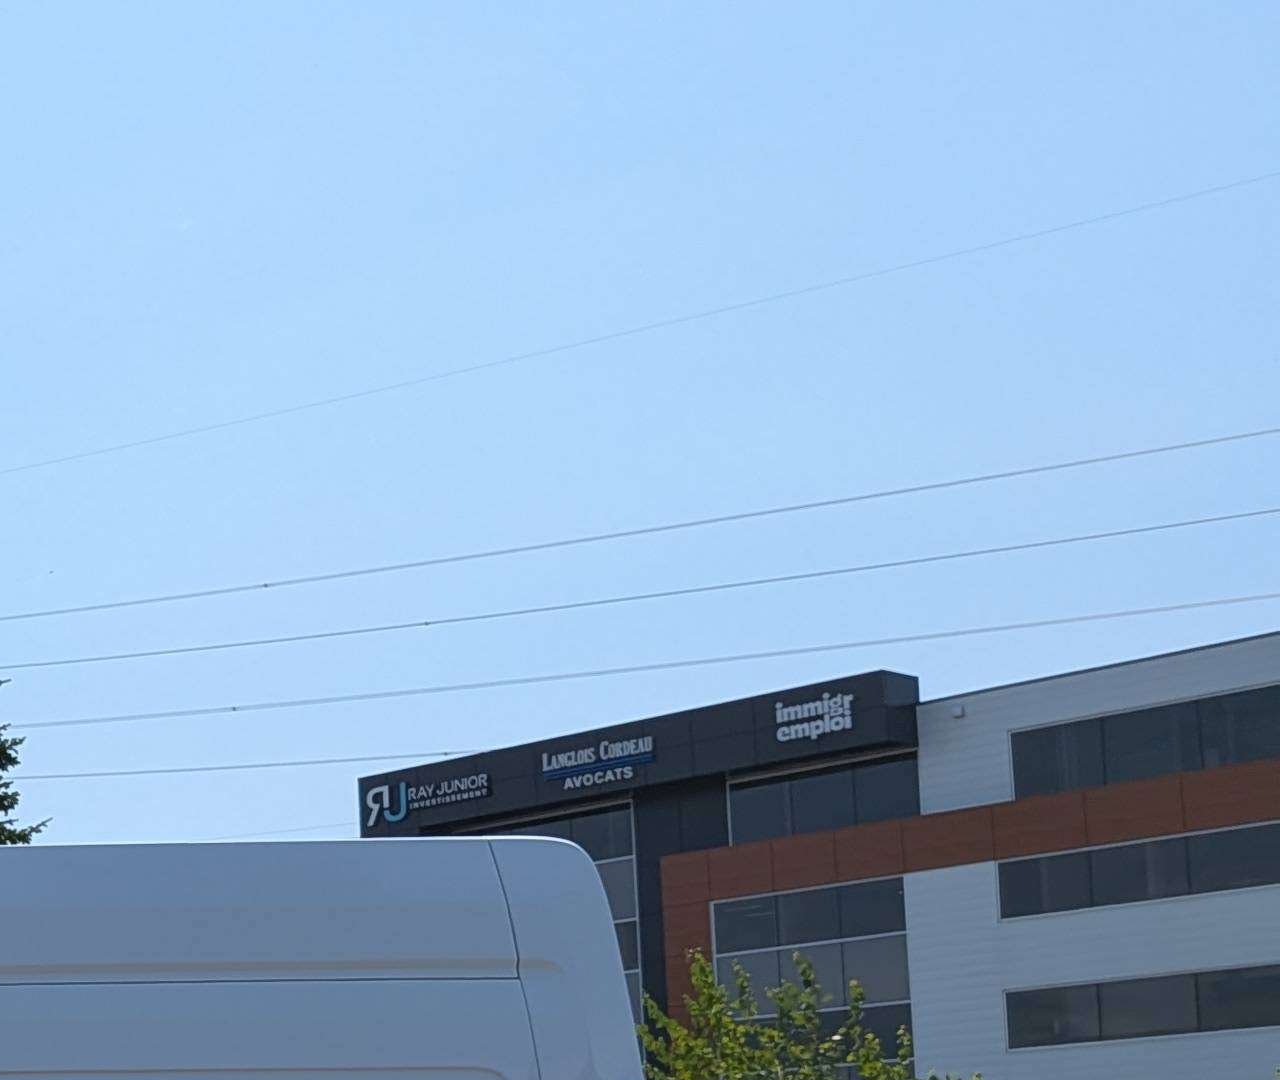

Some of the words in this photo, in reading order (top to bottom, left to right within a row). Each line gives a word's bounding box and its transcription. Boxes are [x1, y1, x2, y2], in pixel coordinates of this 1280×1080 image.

[775, 692, 854, 724] immigr
[776, 708, 853, 742] emploi
[407, 783, 434, 801] RAY
[436, 773, 489, 796] JUNIOR
[563, 766, 634, 790] AVOCATS
